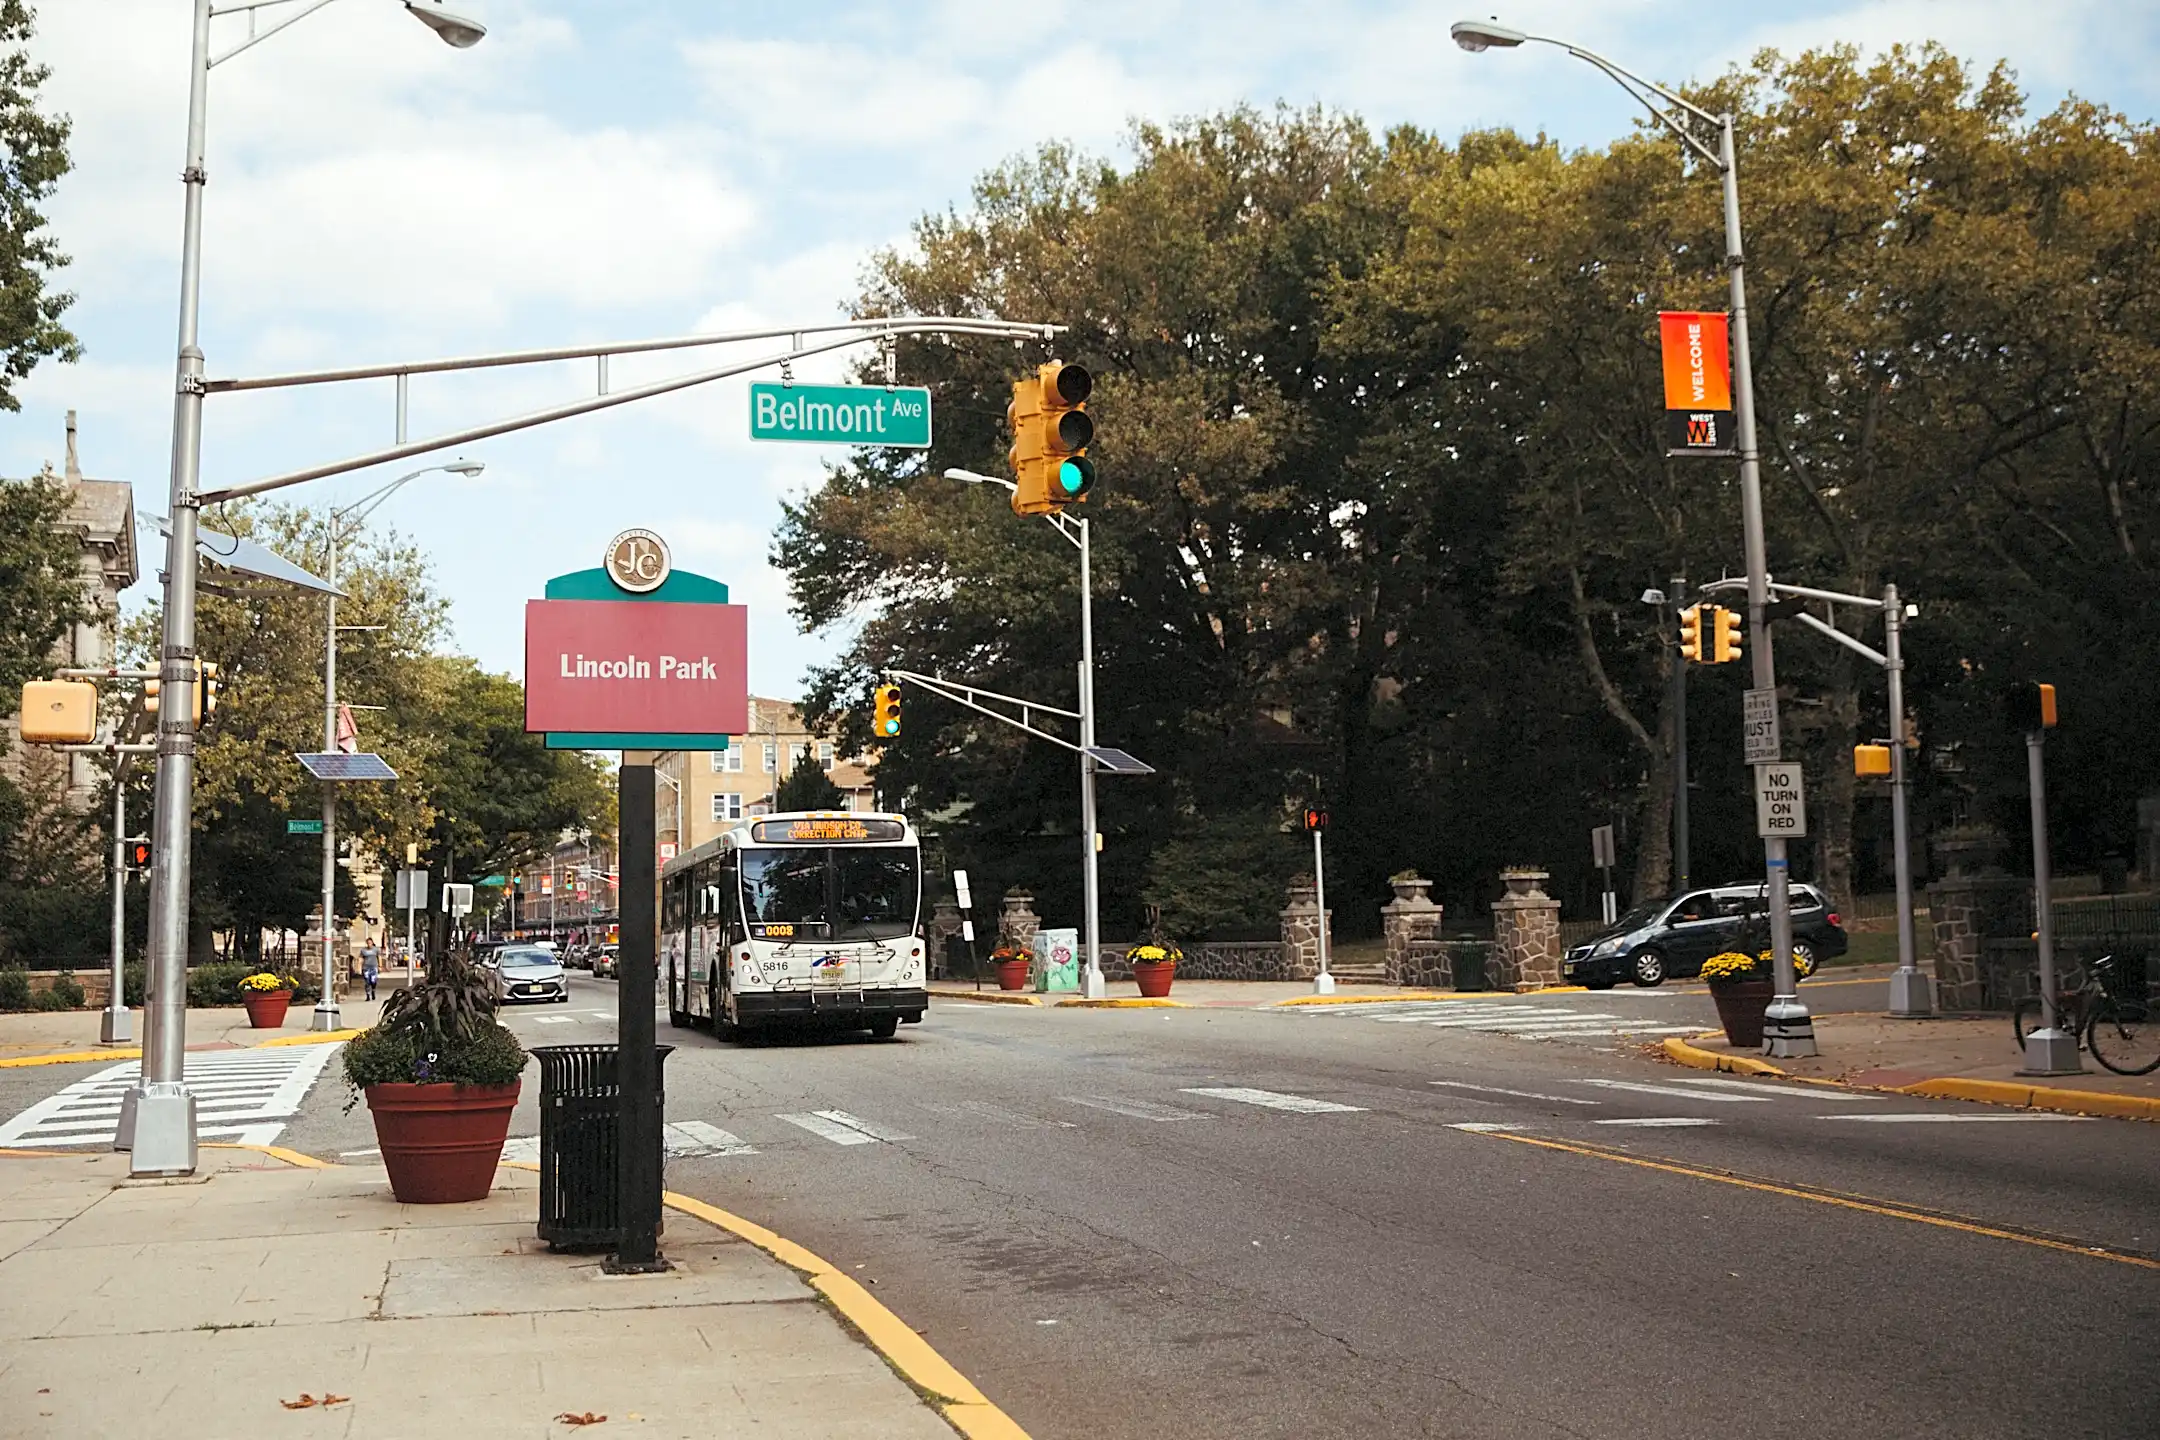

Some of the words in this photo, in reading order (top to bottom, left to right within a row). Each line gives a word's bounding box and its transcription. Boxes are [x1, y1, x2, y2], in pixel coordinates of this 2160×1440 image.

[1688, 323, 1704, 402] WELCOME
[756, 392, 887, 433] Belmont
[891, 398, 922, 418] Ave
[1690, 413, 1714, 422] WEST
[1708, 421, 1717, 443] SIDE
[560, 653, 651, 679] Lincoln
[659, 655, 717, 680] Park
[1769, 774, 1789, 787] NO
[1763, 791, 1798, 802] TURN
[1772, 804, 1791, 814] ON
[794, 821, 811, 830] VIA
[812, 821, 846, 830] HUDSON
[1768, 817, 1795, 828] RED
[760, 823, 766, 840] 1
[788, 829, 841, 839] CORRECTION
[765, 925, 794, 936] 0008
[763, 961, 788, 971] 5816
